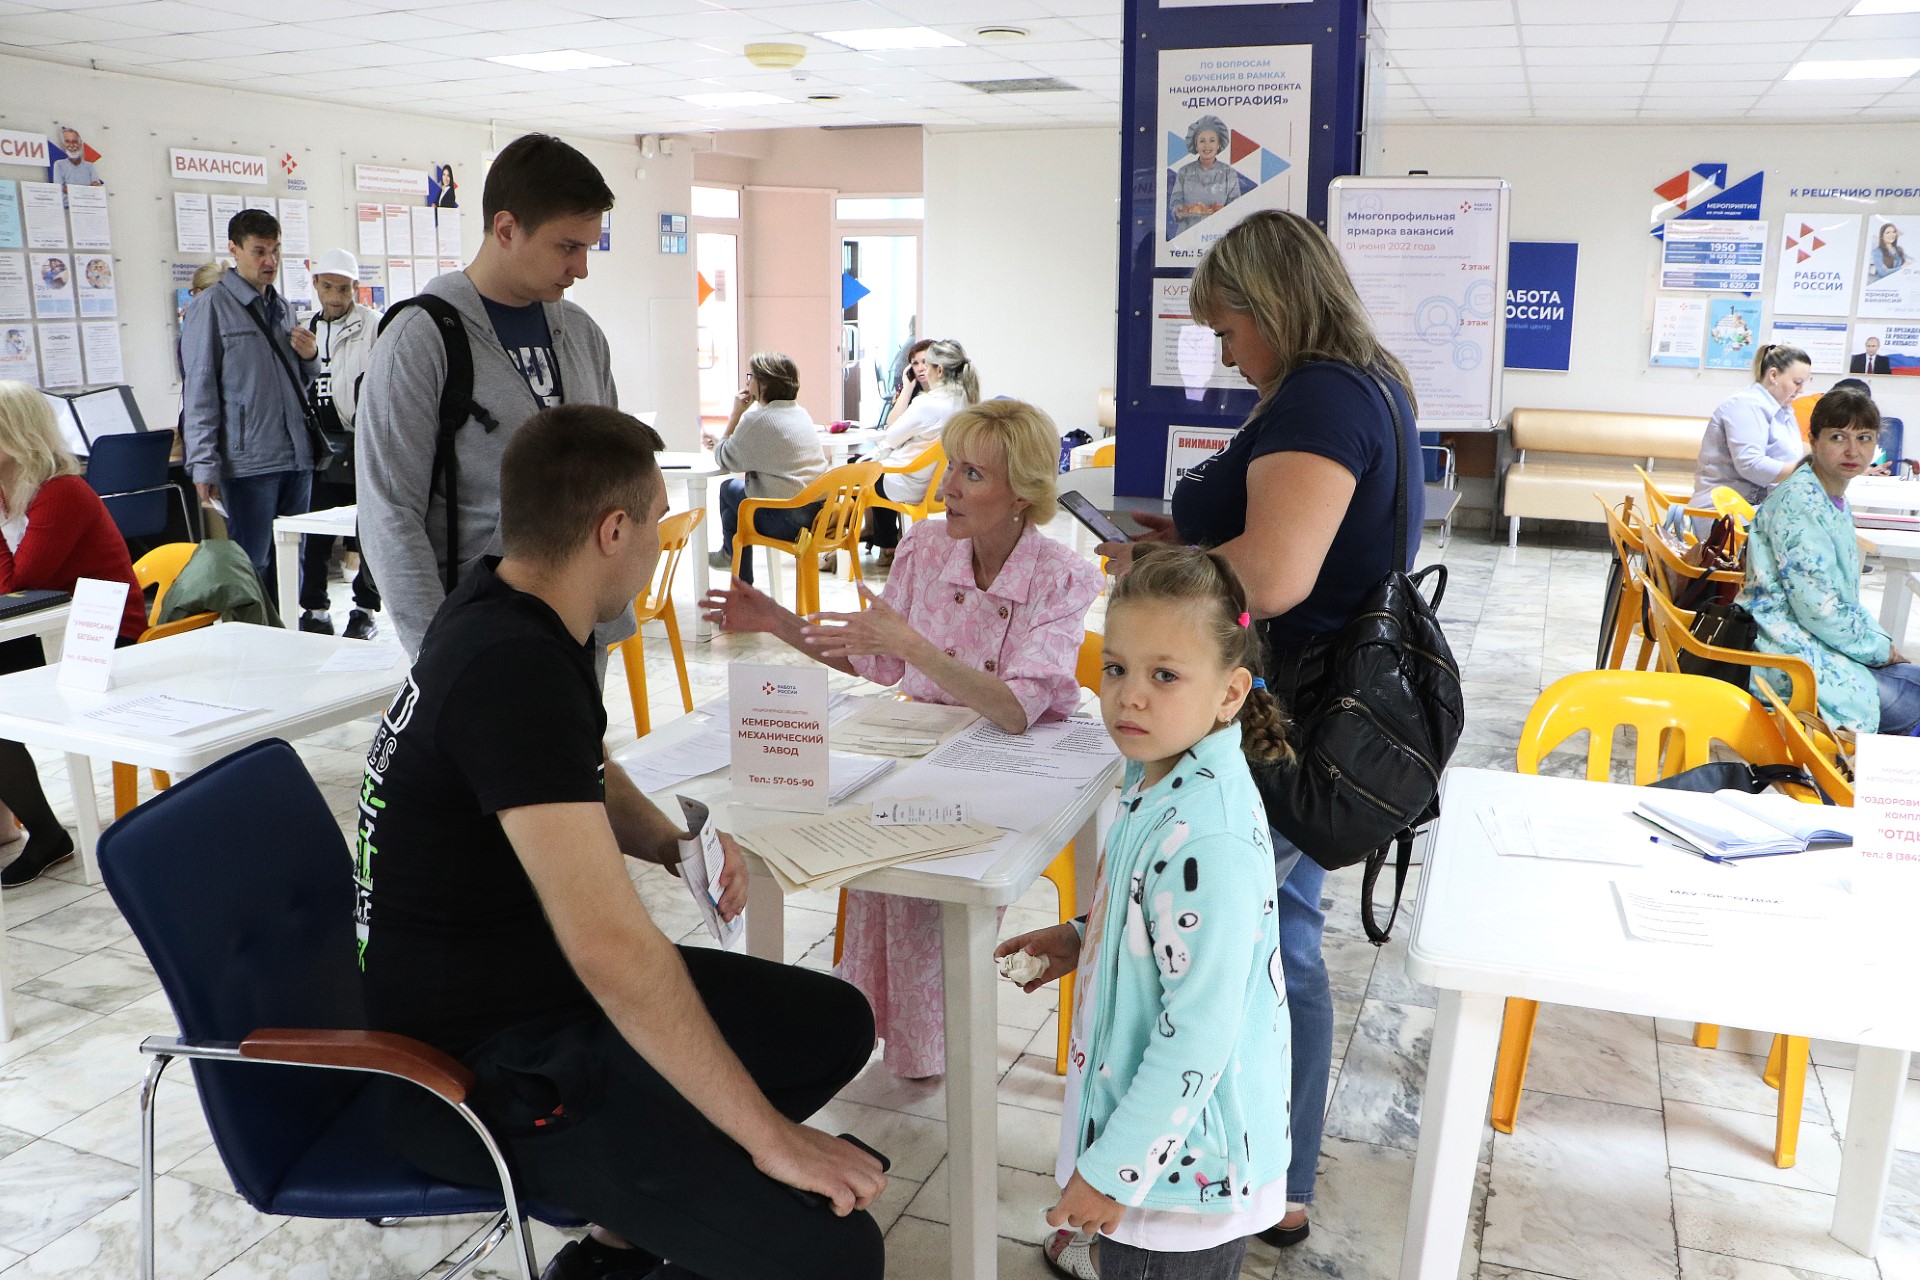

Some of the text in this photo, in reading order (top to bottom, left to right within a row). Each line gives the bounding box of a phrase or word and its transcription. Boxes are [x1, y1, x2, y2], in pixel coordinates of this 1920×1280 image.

[1200, 60, 1270, 69] ПО ВОПРОСАМ
[1184, 73, 1236, 82] ОБУЧЕНИЯ
[1247, 72, 1286, 80] РАМКАХ
[1169, 83, 1302, 95] НАЦИОНАЛЬНОГО ПРОЕКТА
[1181, 95, 1289, 109] «ДЕМОГРАФИЯ»
[1, 138, 45, 159] СИИ
[175, 156, 264, 177] ВАКАНСИИ
[1790, 188, 1920, 198] К РЕШЕНИЮ ПРОБЛ
[1347, 211, 1456, 222] Многопрофильная
[1347, 226, 1454, 237] ярмарка вакансий
[1388, 242, 1411, 250] 2022
[1413, 244, 1436, 252] года
[1710, 243, 1736, 252] 1950
[1170, 249, 1194, 257] тел.:
[1794, 271, 1841, 280] РАБОТА
[1163, 285, 1191, 296] КУР
[1793, 281, 1843, 291] РОССИИ
[1507, 289, 1561, 304] АБОТА
[1506, 305, 1564, 320] ОССИИ
[742, 717, 820, 731] КЕМЕРОВСКИЙ
[738, 730, 824, 744] МЕХАНИЧЕСКИЙ
[762, 745, 799, 757] ЗАВОД
[749, 774, 815, 787] Тел.: 57-05-90
[1860, 795, 1920, 807] "ОЗДОРОВИ
[1885, 811, 1920, 821] КОМПЛ
[1861, 850, 1884, 859] тел.:
[1886, 852, 1893, 860] 8
